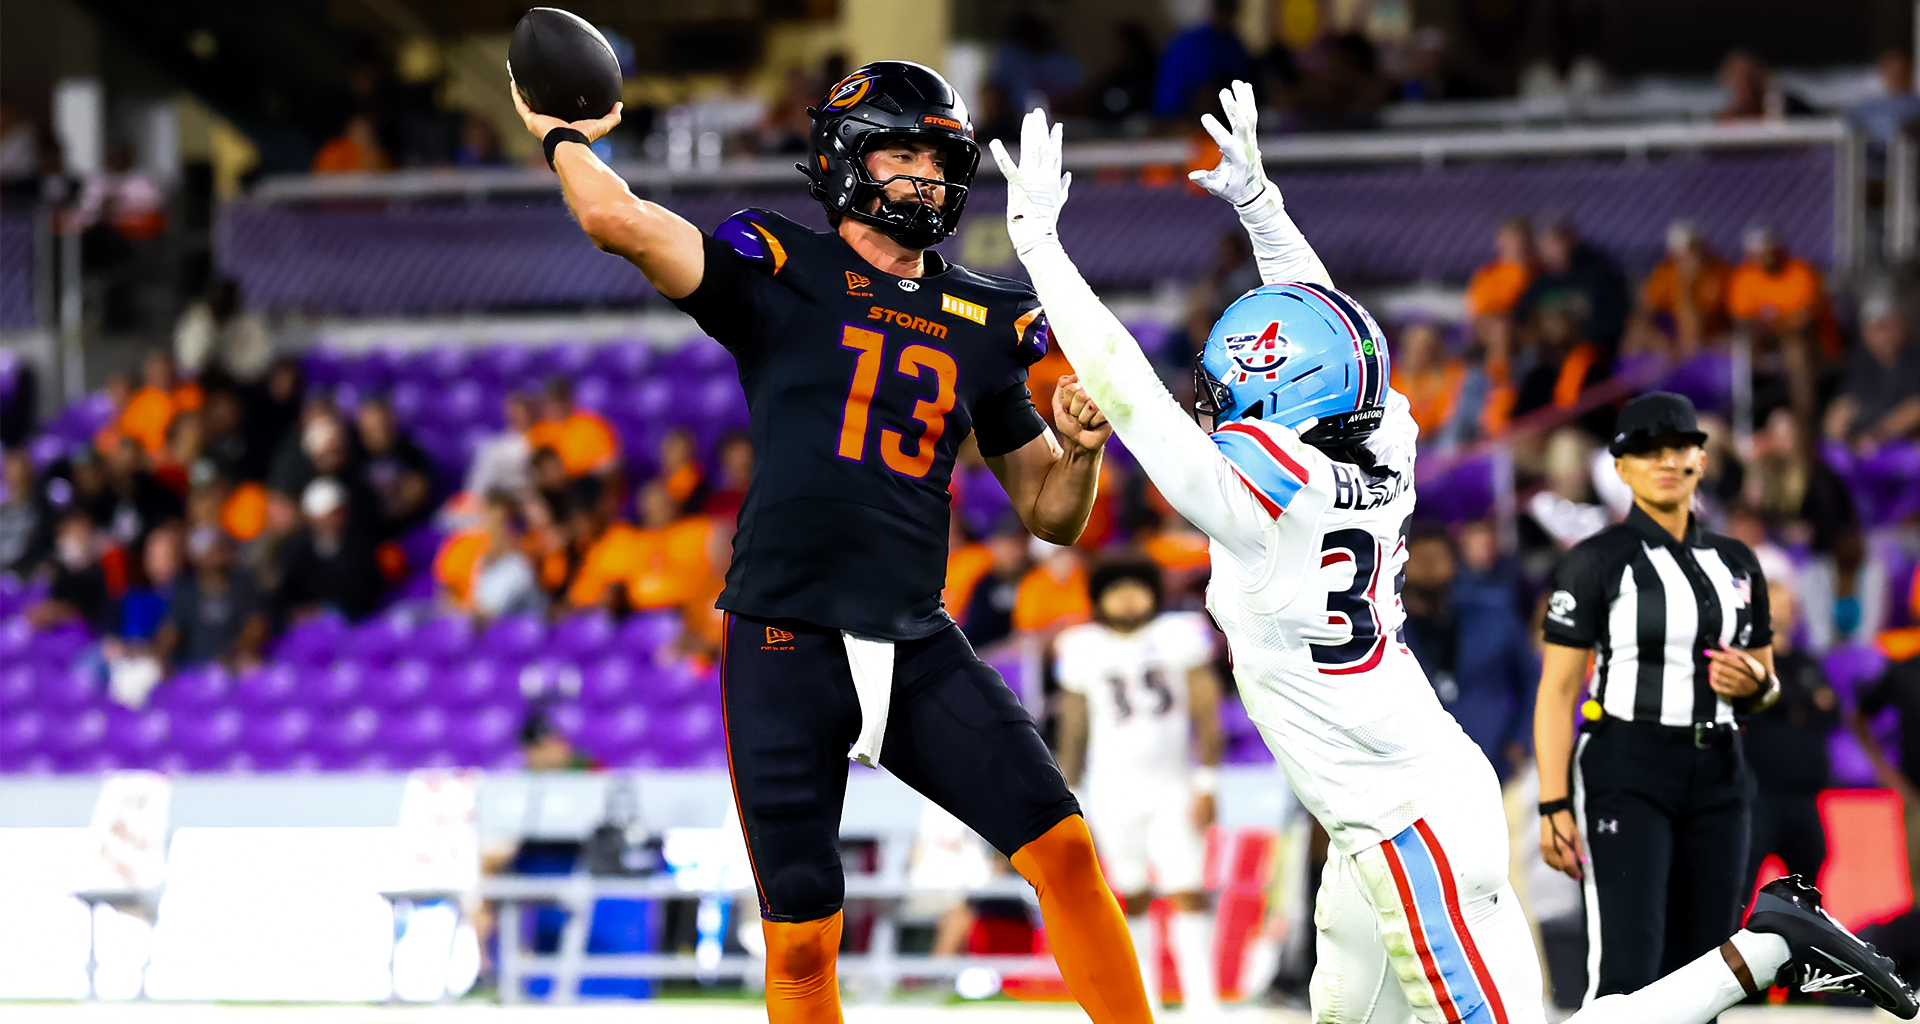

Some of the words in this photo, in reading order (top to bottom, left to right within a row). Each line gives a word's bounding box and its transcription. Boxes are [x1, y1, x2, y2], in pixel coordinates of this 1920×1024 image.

[923, 116, 961, 130] STORM
[899, 281, 917, 291] UFL
[942, 297, 986, 323] NOBULL
[867, 306, 949, 339] STORM
[835, 321, 960, 481] 13
[1347, 409, 1383, 424] AVIATORS
